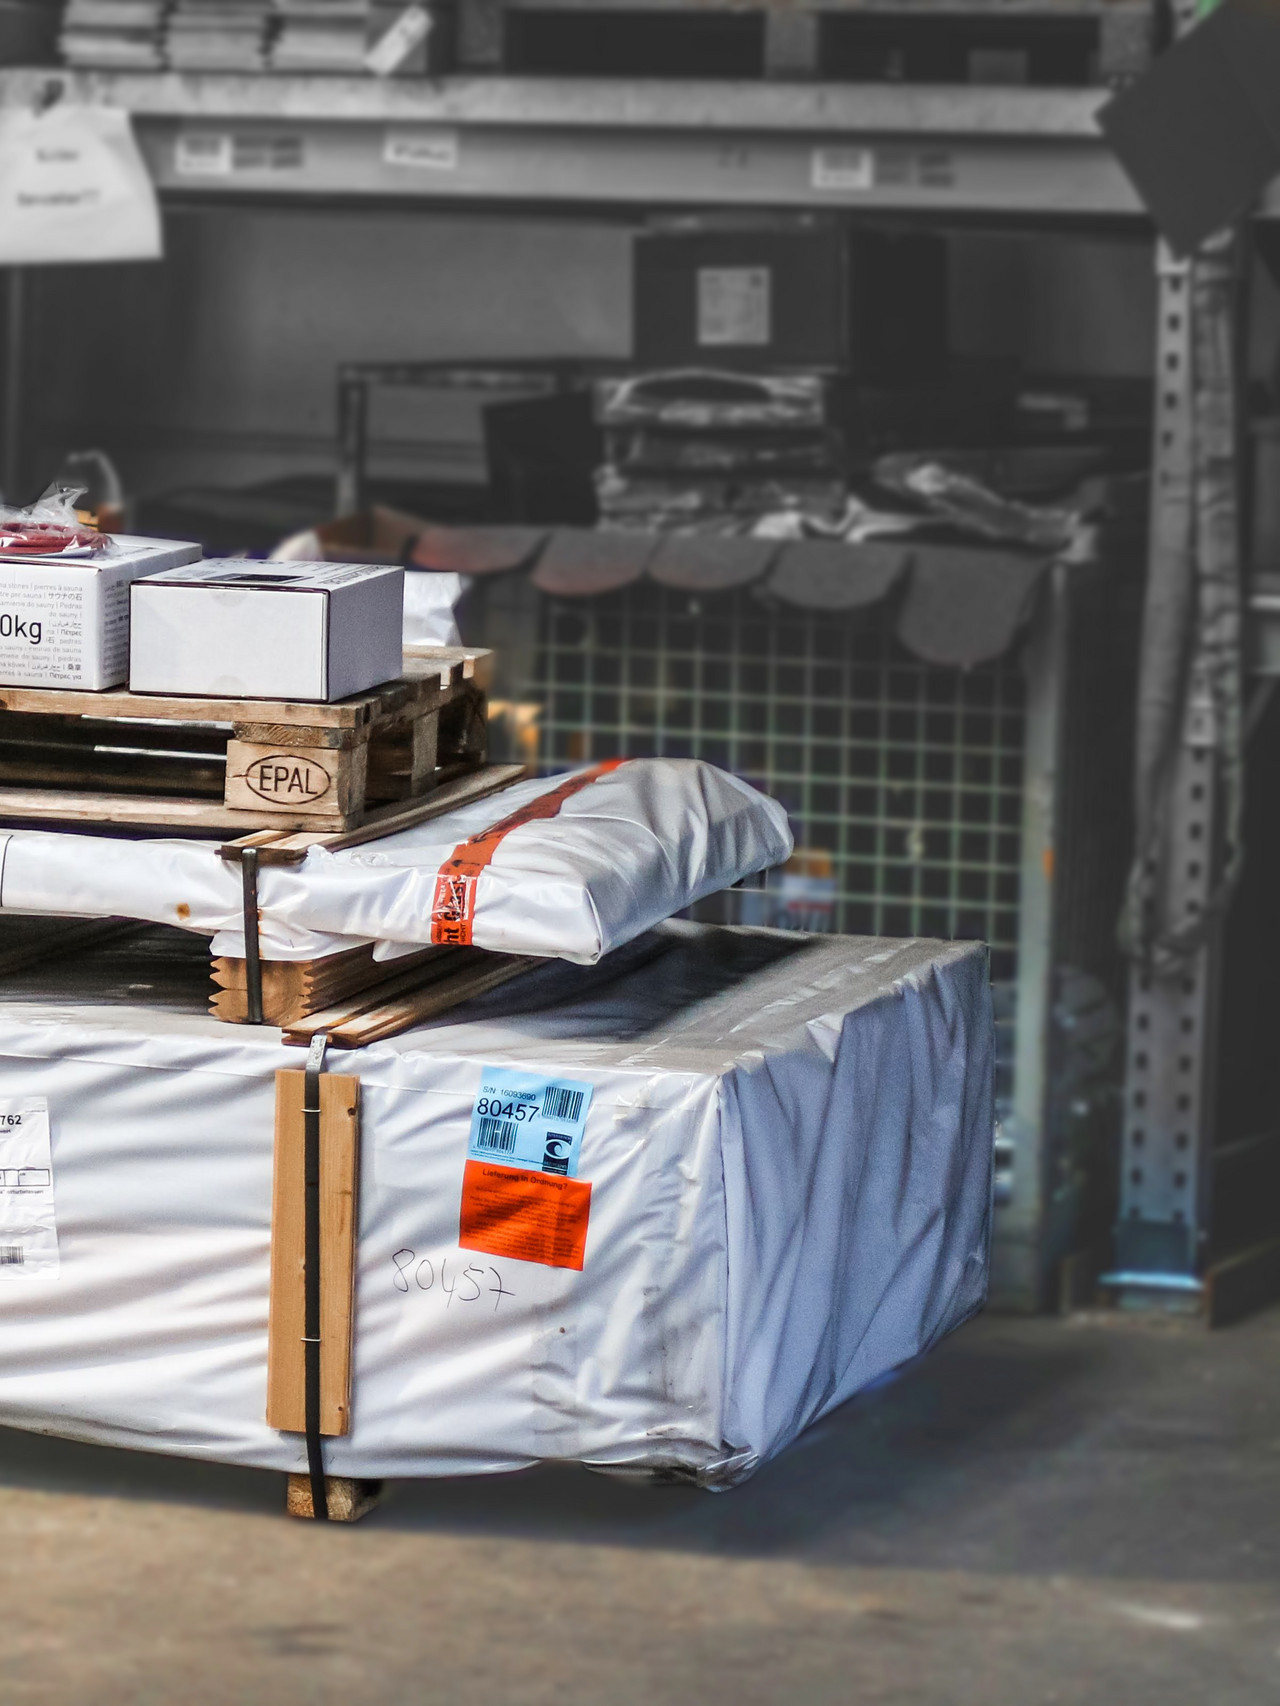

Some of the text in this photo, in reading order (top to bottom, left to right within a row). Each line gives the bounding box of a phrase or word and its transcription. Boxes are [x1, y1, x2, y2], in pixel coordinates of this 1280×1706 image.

[258, 765, 319, 795] EPAL
[482, 1086, 497, 1095] S/N
[0, 1114, 22, 1126] 762
[477, 1097, 541, 1123] 80457
[482, 1168, 569, 1191] Lieferung in Ordnung?
[391, 1248, 516, 1312] 80457
